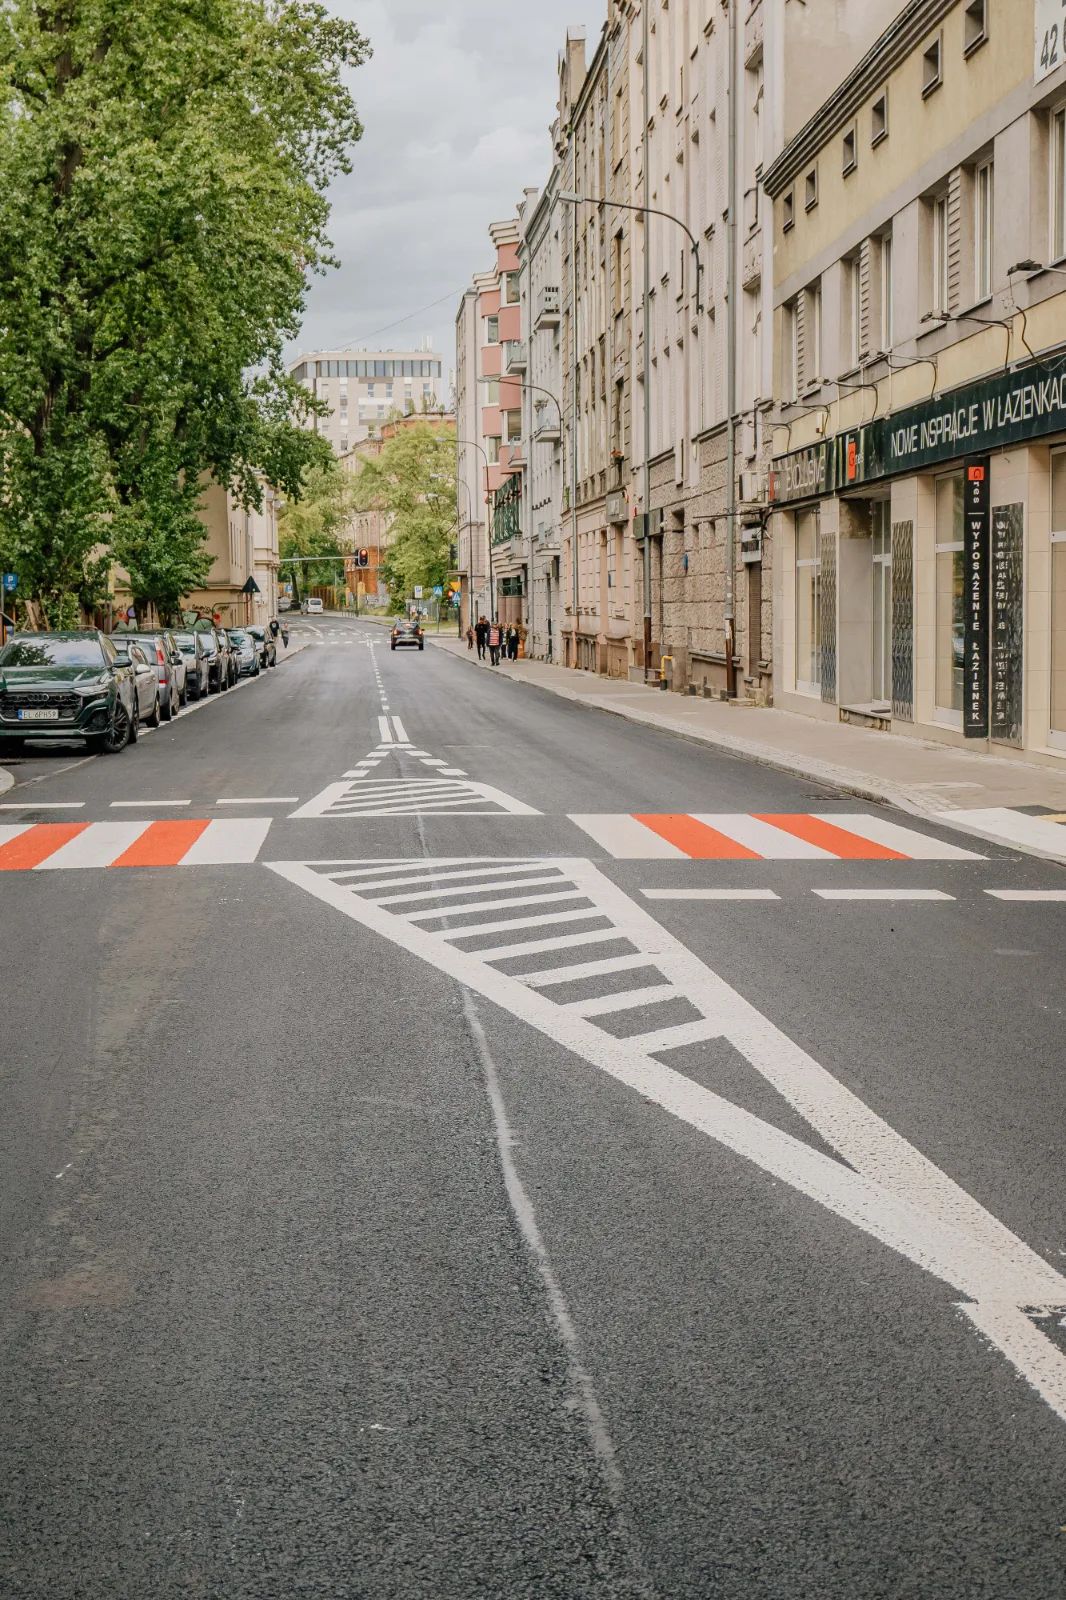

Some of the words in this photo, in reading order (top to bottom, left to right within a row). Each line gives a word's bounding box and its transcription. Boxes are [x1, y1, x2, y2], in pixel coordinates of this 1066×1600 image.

[1040, 23, 1058, 70] 42
[890, 424, 918, 458] NOWE
[920, 403, 979, 450] INSPIRACJE
[982, 397, 996, 431] W
[971, 521, 981, 630] WYPOSAŻENIE
